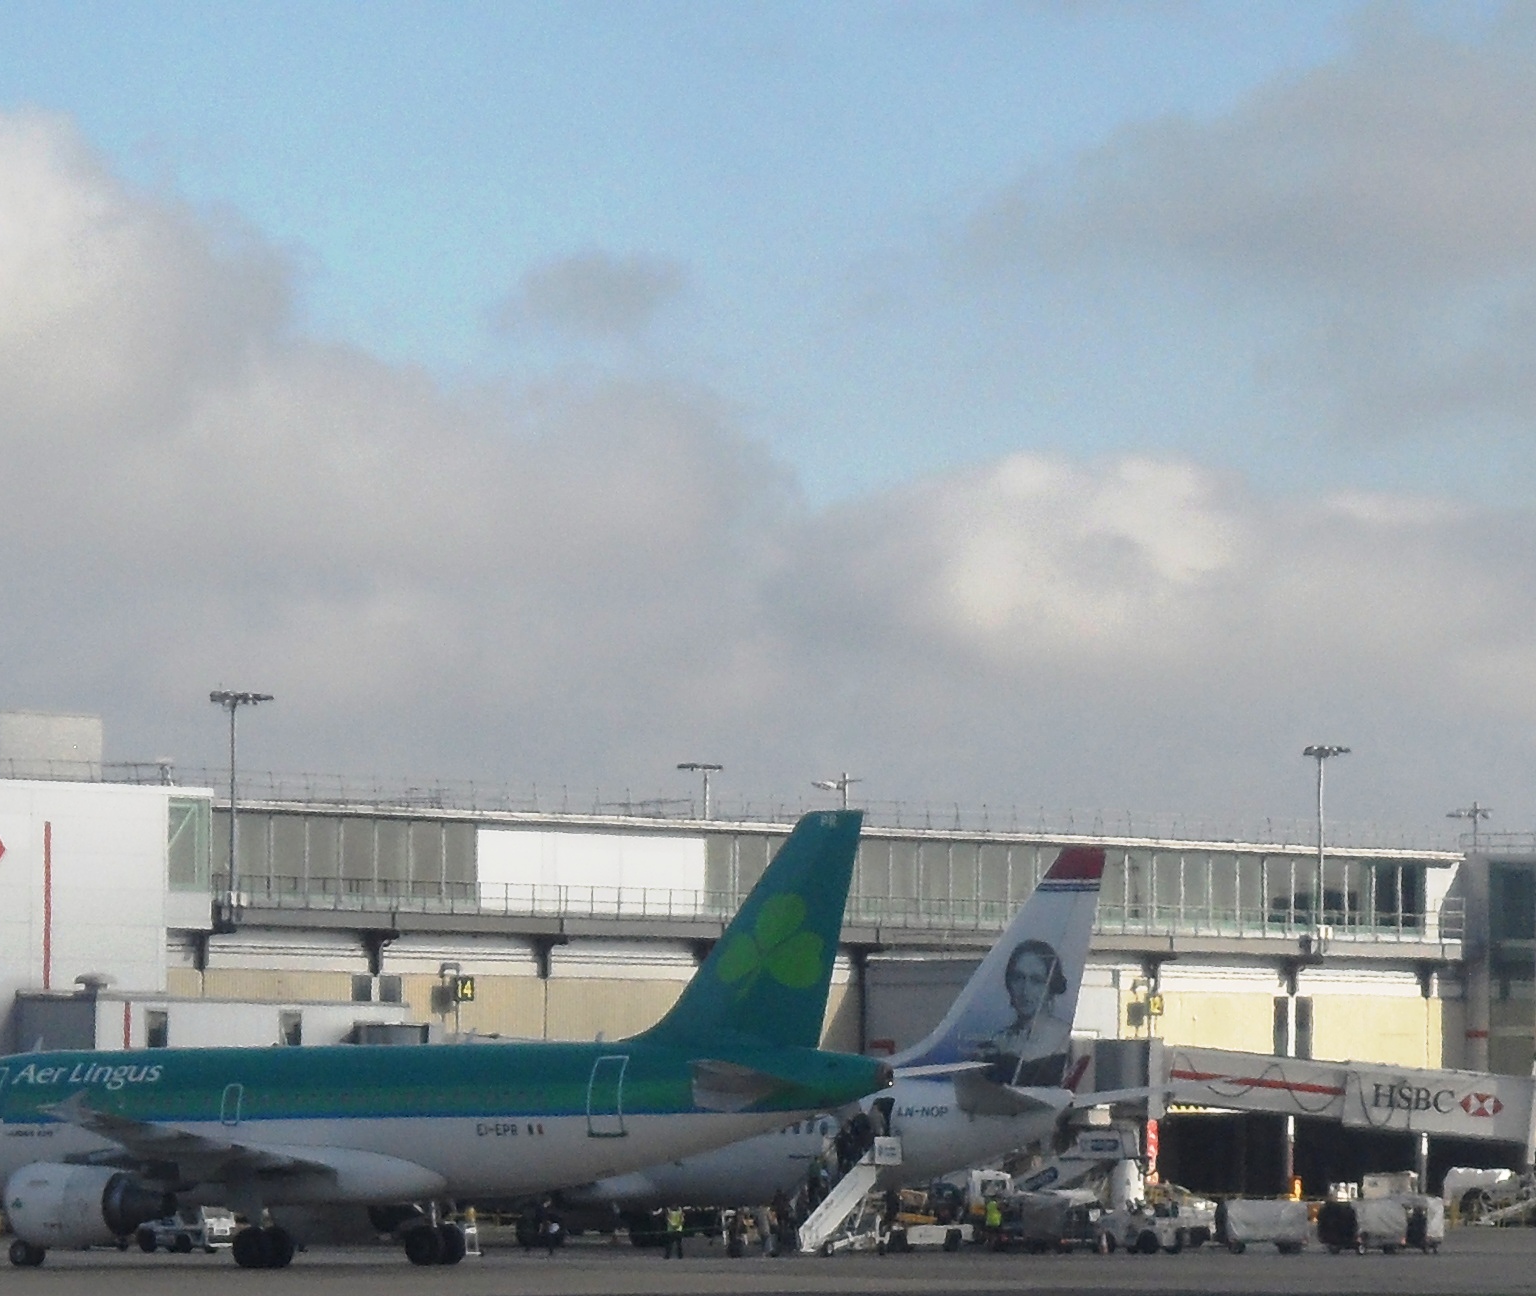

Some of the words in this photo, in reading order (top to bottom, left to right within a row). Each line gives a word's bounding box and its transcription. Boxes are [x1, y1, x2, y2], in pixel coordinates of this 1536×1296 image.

[457, 979, 473, 999] 14
[11, 1063, 66, 1085] Aer
[68, 1063, 163, 1090] Lingus
[1371, 1083, 1455, 1114] HSBC
